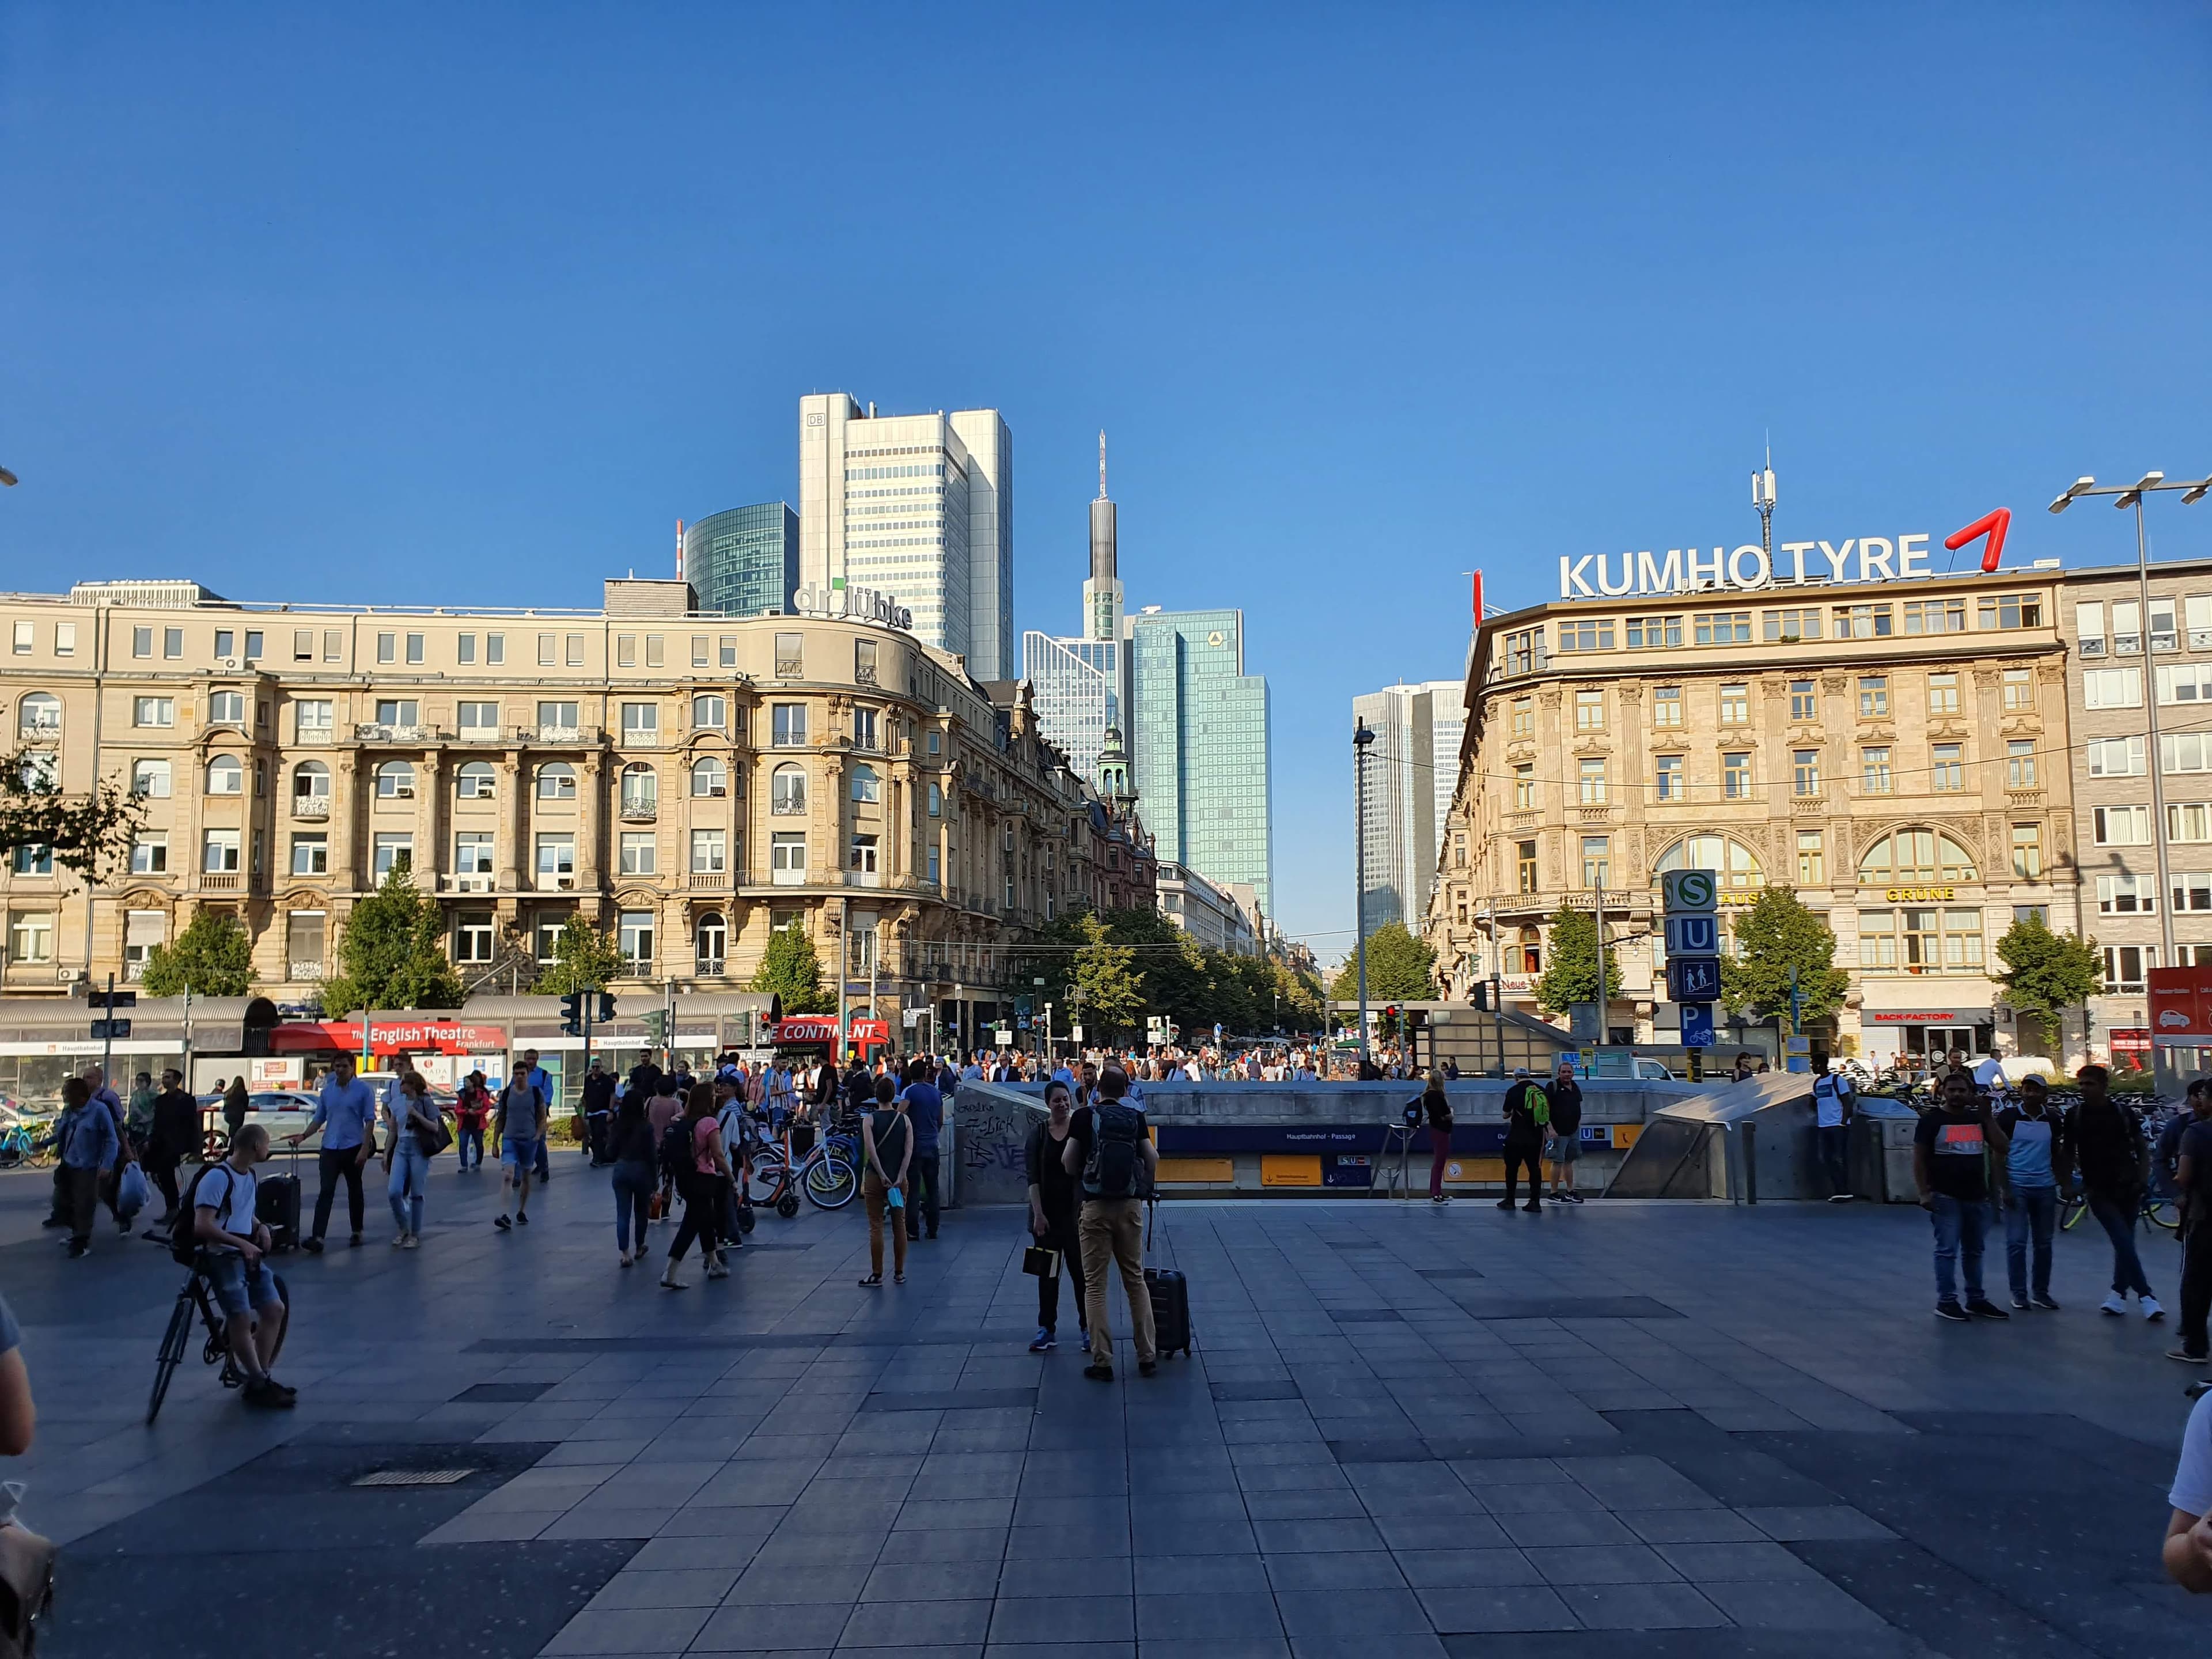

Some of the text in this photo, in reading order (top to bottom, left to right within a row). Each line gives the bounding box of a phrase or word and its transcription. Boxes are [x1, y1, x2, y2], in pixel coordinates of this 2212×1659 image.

[810, 415, 823, 425] DB
[1559, 533, 1932, 599] KUMHO TYRE
[793, 581, 913, 631] dr lübke
[1684, 876, 1707, 904] S
[1721, 886, 1955, 905] AUS GRÜNE
[1687, 921, 1708, 948] U
[1502, 979, 1526, 990] Neue
[1683, 1006, 1699, 1029] P
[371, 1027, 421, 1044] English
[422, 1026, 476, 1040] Theatre
[456, 1040, 495, 1048] Frankfurt
[1583, 1128, 1590, 1139] U
